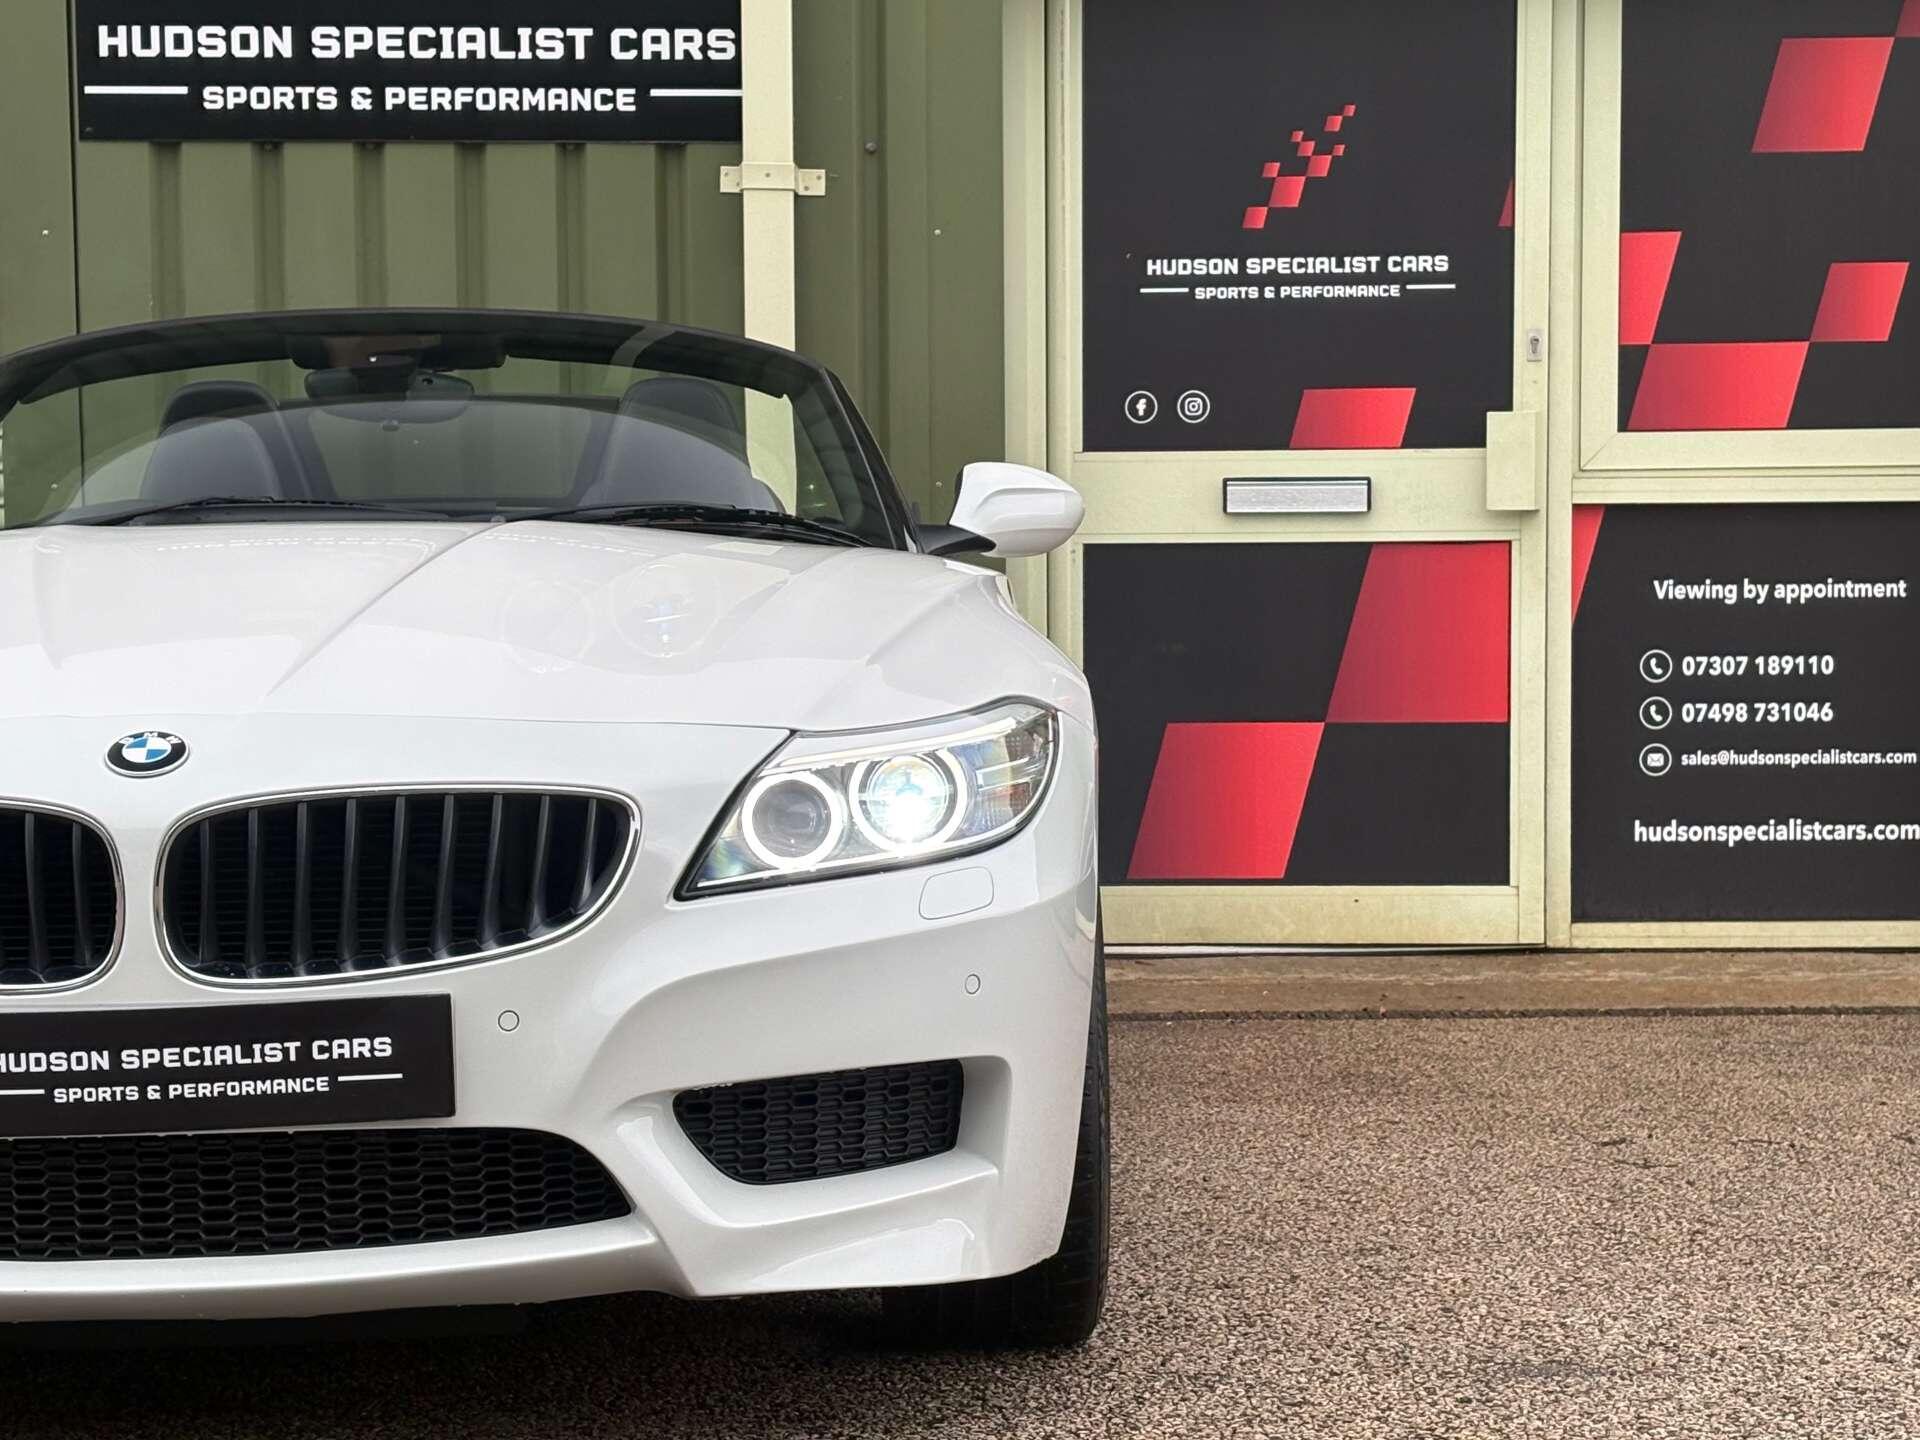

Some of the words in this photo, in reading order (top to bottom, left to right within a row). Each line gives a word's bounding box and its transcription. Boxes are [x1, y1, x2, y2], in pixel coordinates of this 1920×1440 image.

[98, 25, 293, 59] HUDSON
[311, 26, 594, 60] SPECIALIST
[610, 28, 736, 61] CARS
[202, 86, 338, 111] SPORTS
[350, 86, 373, 111] &
[384, 86, 637, 112] PERFORMANCE
[1146, 257, 1239, 276] HUDSON
[1245, 255, 1381, 275] SPECIALIST
[1387, 254, 1450, 273] CARS
[1194, 286, 1260, 300] SPORTS
[1263, 286, 1276, 299] &
[1279, 284, 1401, 299] PERFORMANCE
[1652, 578, 1738, 605] Viewing
[1743, 577, 1770, 605] by
[1773, 577, 1907, 605] appointment
[1681, 655, 1749, 677] 07307
[1754, 654, 1835, 676] 189110
[1681, 702, 1749, 724] 07498
[1753, 701, 1834, 723] 731046
[1681, 748, 1918, 769] sales@hudsonspecialistcars.com
[1634, 817, 1920, 848] hudsonspecialistcars.com
[120, 1041, 302, 1070] SPECIALIST
[311, 1036, 393, 1060] CARS
[53, 1085, 140, 1103] SPORTS
[146, 1084, 161, 1100] &
[168, 1076, 330, 1099] PERFORMANCE
